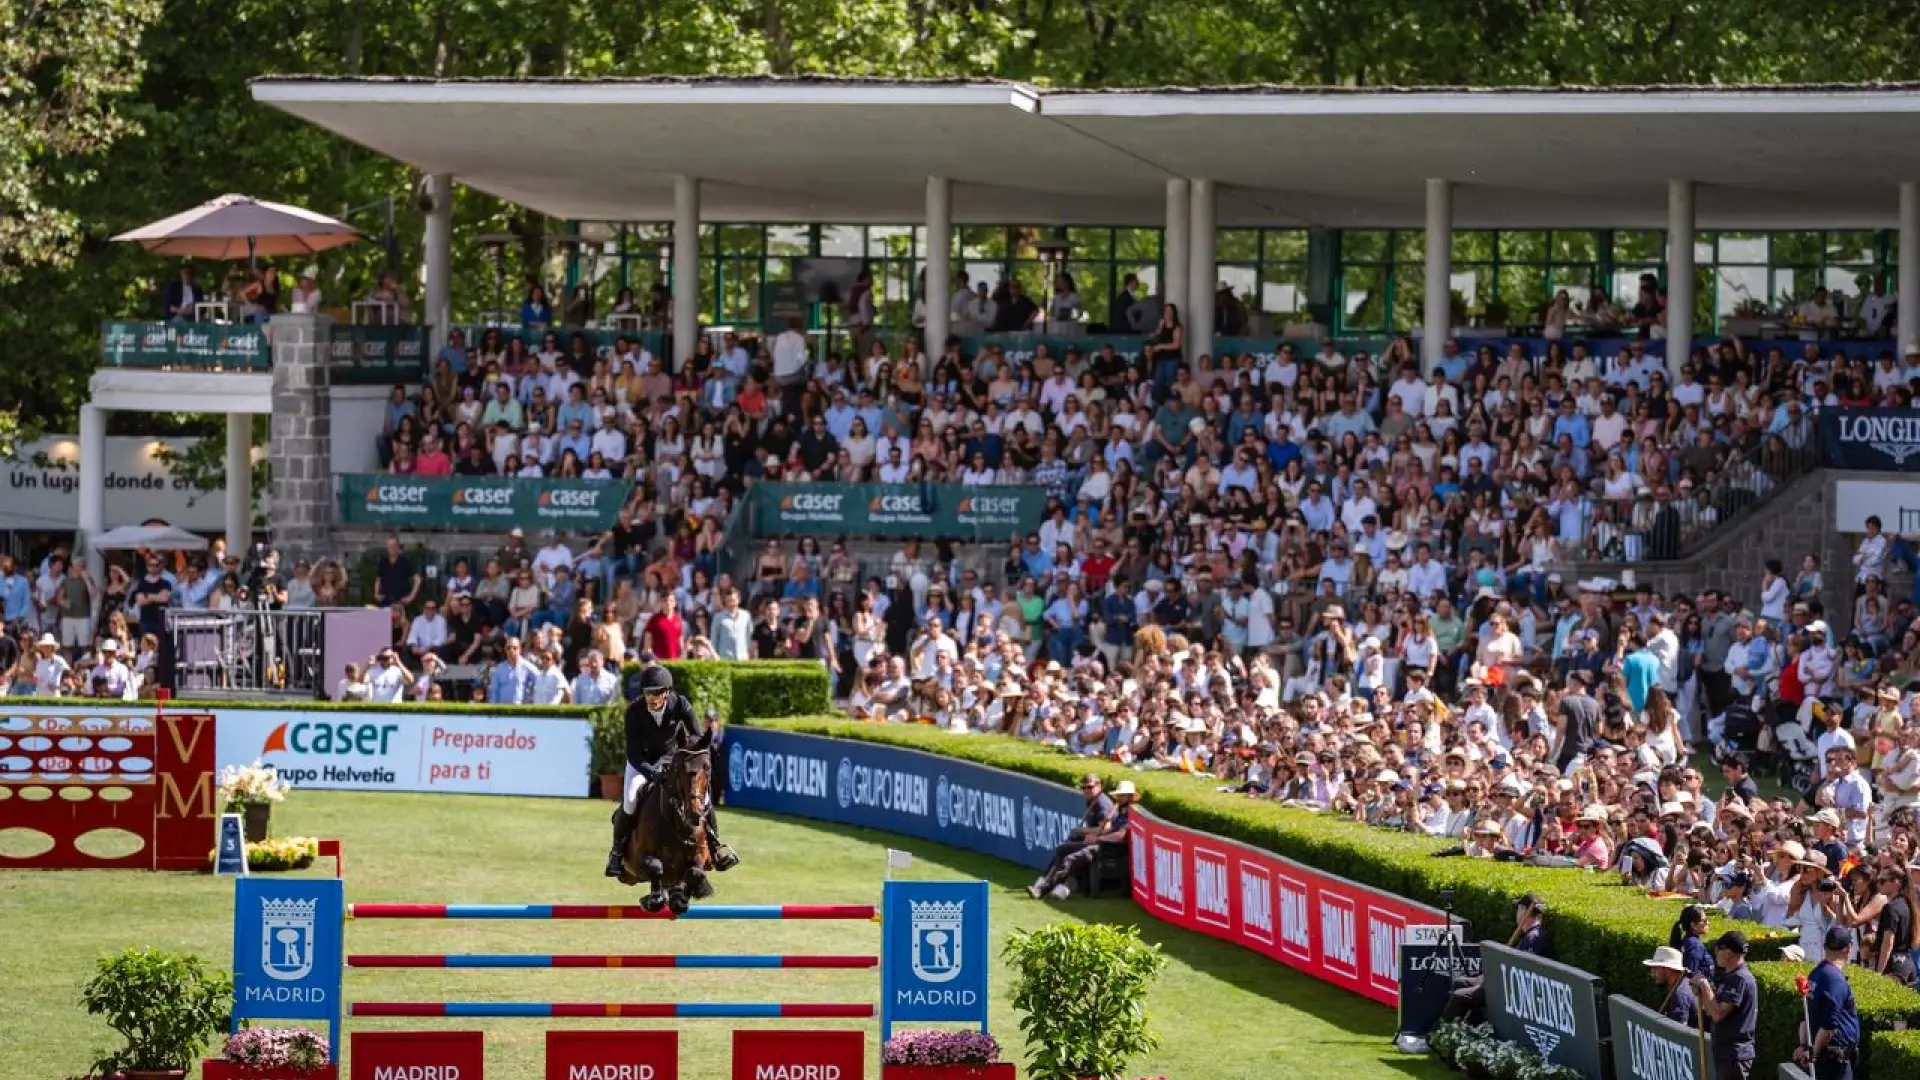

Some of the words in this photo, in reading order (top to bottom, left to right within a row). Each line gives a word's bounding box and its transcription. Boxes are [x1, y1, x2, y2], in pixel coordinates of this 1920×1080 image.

[10, 472, 37, 488] Un
[42, 471, 79, 493] lug
[104, 472, 164, 489] donde
[378, 485, 428, 501] caser
[464, 487, 514, 503] caser
[550, 489, 600, 506] caser
[791, 494, 843, 510] caser
[881, 495, 921, 511] case
[162, 716, 211, 763] V
[290, 722, 399, 756] caser
[432, 727, 537, 752] Preparados
[322, 766, 396, 784] Helvetia
[430, 763, 470, 784] para
[477, 761, 491, 780] ti
[743, 749, 784, 792] GRUPO
[786, 754, 828, 798] EULEN
[156, 772, 216, 819] M
[851, 765, 893, 810] GRUPO
[893, 771, 929, 816] EULEN
[949, 783, 983, 831] GRUPO
[983, 791, 1017, 838] EULEN
[226, 839, 235, 851] 3
[1415, 928, 1456, 941] STA
[245, 986, 325, 1003] MADRID
[897, 990, 977, 1006] MADRID
[1500, 963, 1576, 1037] LONGINES
[374, 1065, 460, 1080] MADRID
[569, 1064, 655, 1080] MADRID
[756, 1064, 841, 1080] MADRID
